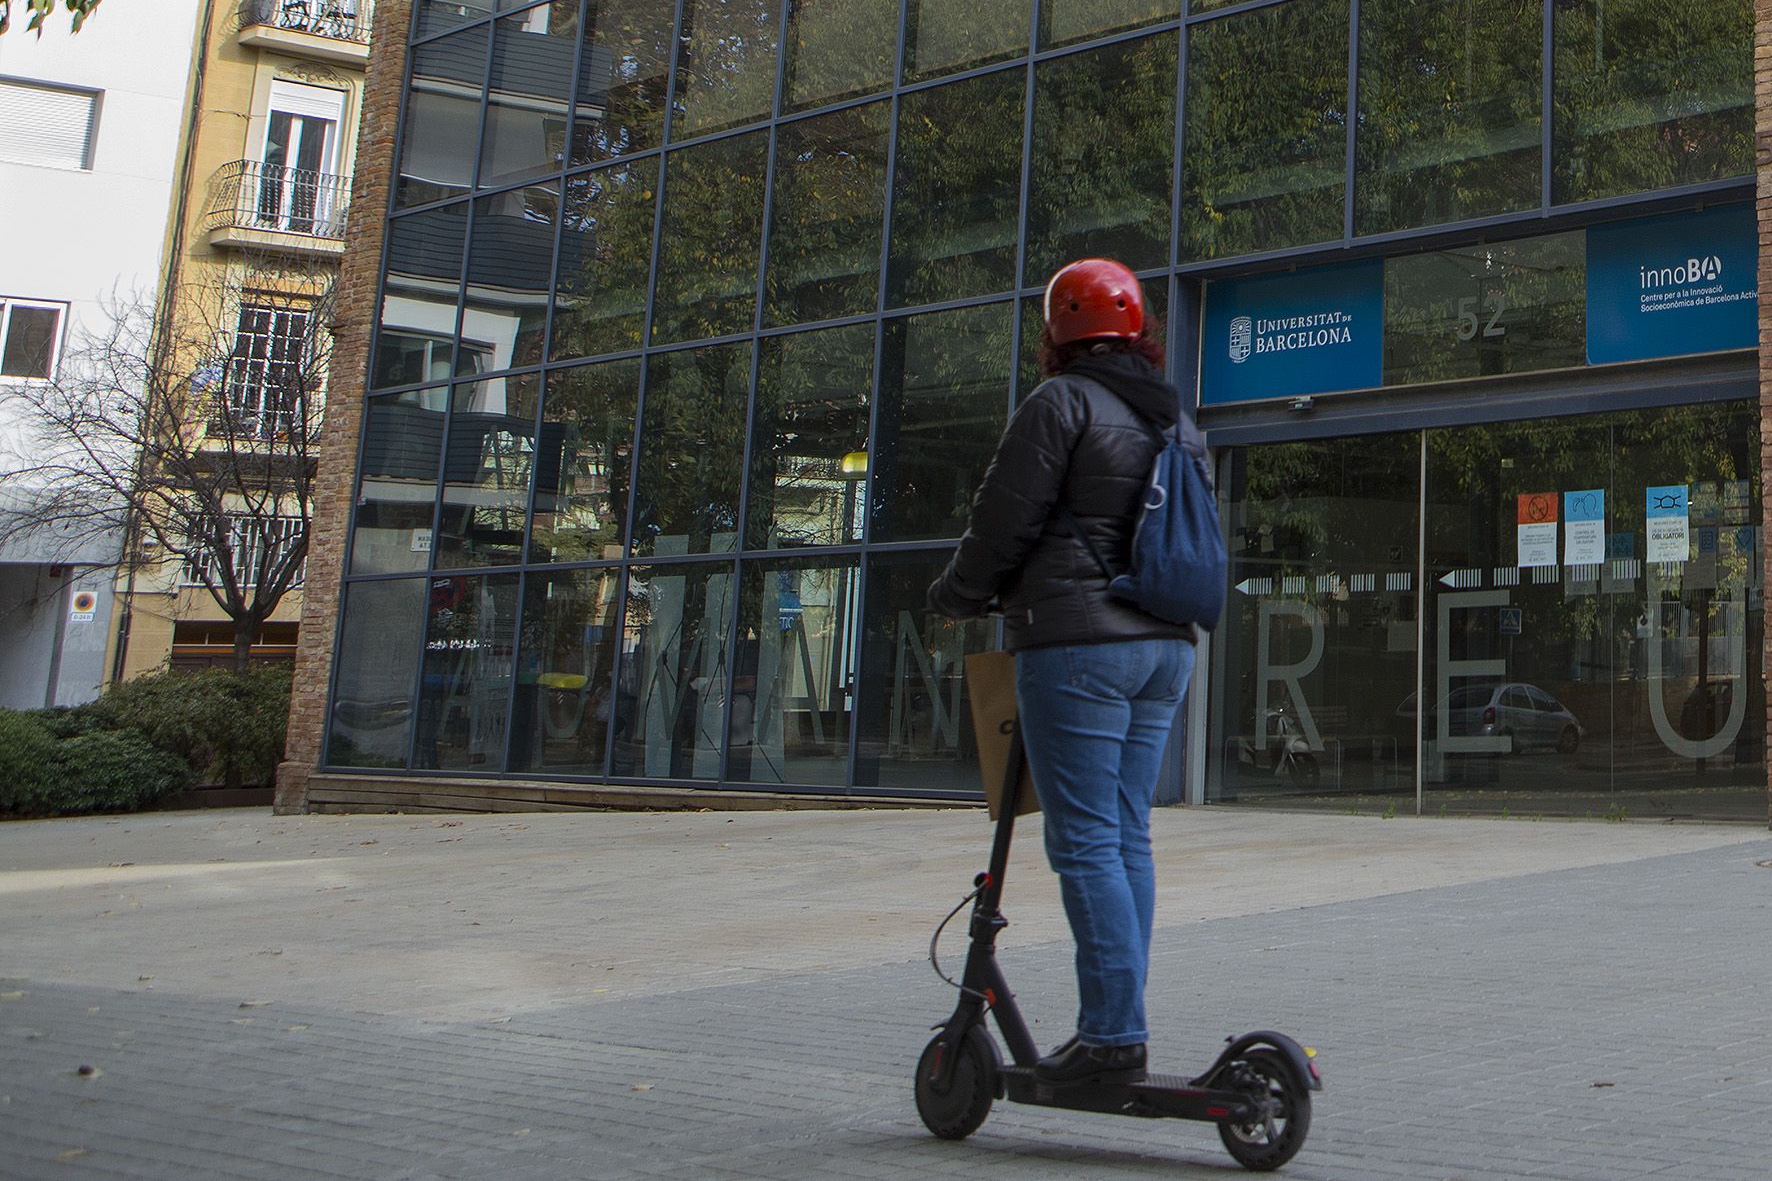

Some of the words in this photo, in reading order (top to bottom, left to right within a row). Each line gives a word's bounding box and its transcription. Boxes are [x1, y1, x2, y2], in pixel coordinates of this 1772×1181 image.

[1640, 255, 1722, 289] innoBA
[1640, 294, 1663, 303] Centre
[1664, 292, 1676, 302] per
[1682, 289, 1689, 297] la
[1690, 285, 1723, 297] Innovació
[1640, 301, 1695, 313] Socioeconòmica
[1695, 298, 1704, 306] de
[1705, 293, 1740, 305] Barcelona
[1740, 289, 1760, 300] Activ
[1456, 293, 1506, 340] 52
[1256, 327, 1352, 354] BARCELONA
[1651, 532, 1685, 540] OBLIGATORI
